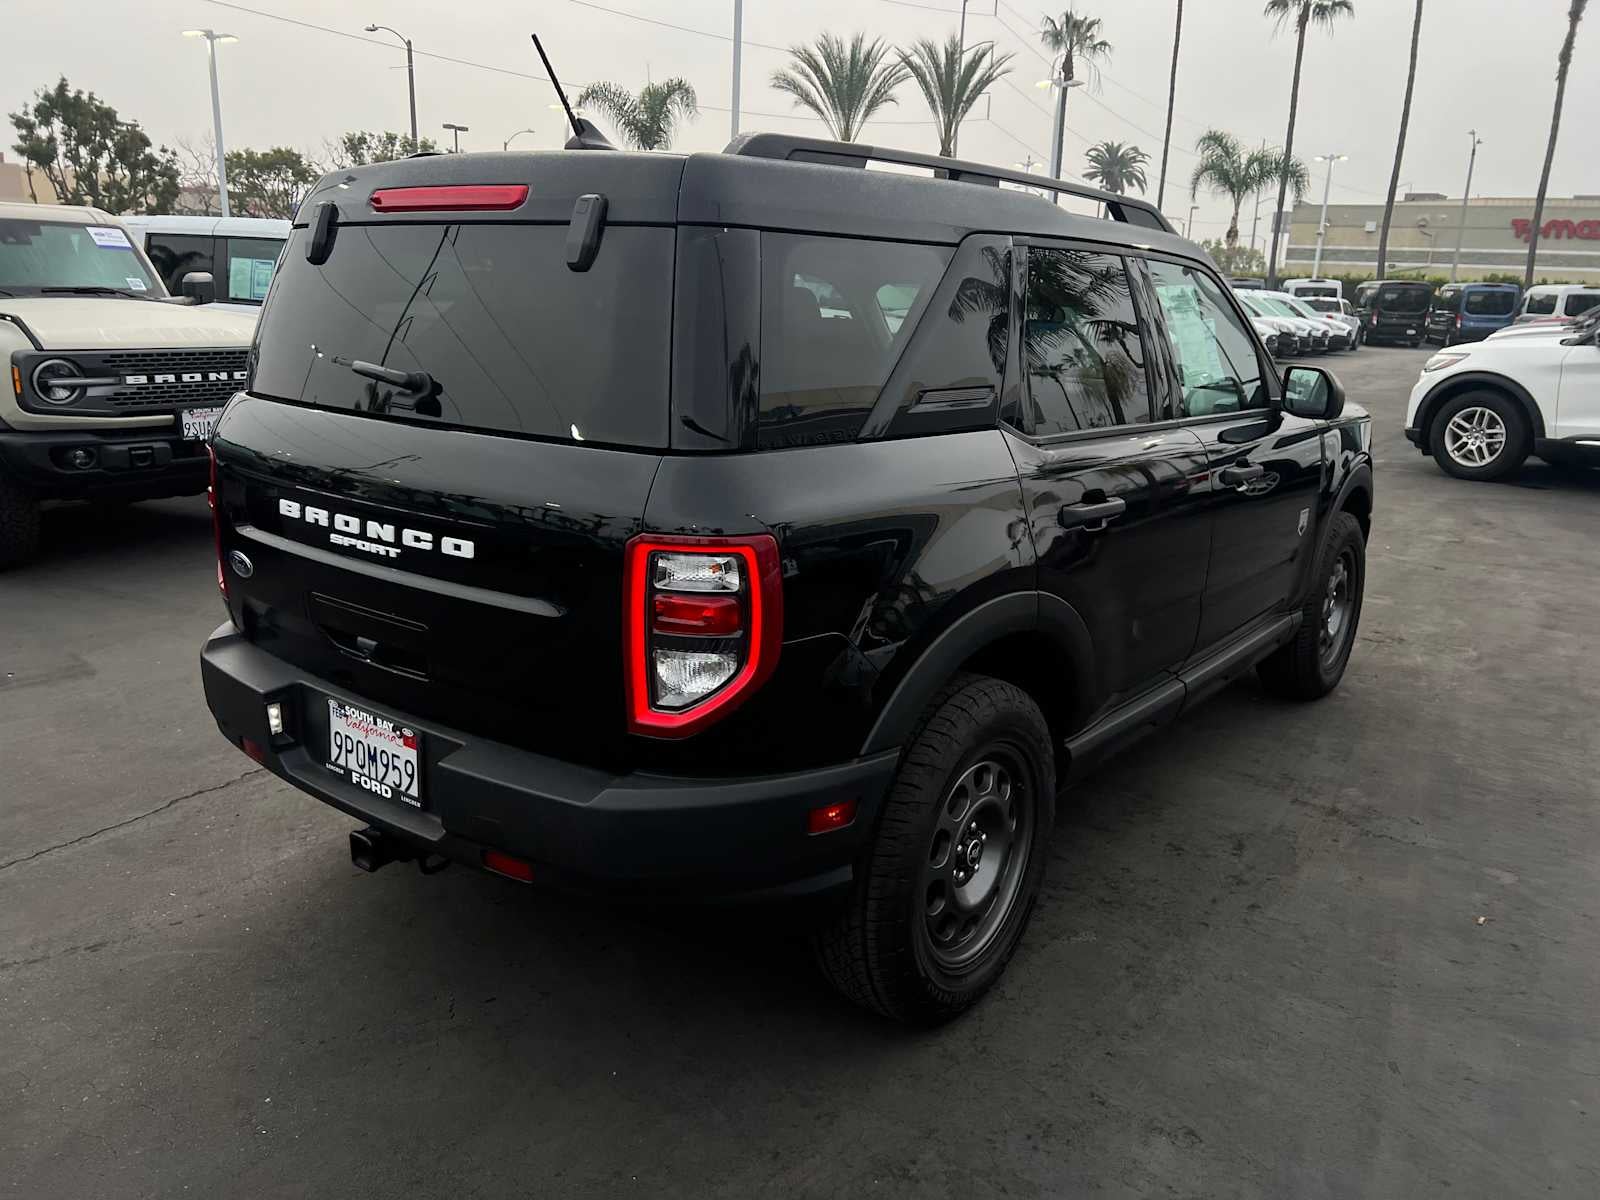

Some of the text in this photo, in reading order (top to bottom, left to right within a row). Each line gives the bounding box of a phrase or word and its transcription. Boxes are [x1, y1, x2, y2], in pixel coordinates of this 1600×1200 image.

[125, 371, 248, 385] BRONC
[279, 498, 475, 559] BRONCO
[329, 533, 402, 558] SPORT
[344, 705, 374, 725] SOUTH
[376, 717, 395, 732] BAY
[334, 731, 415, 793] 9PQM959
[351, 771, 393, 799] FORD
